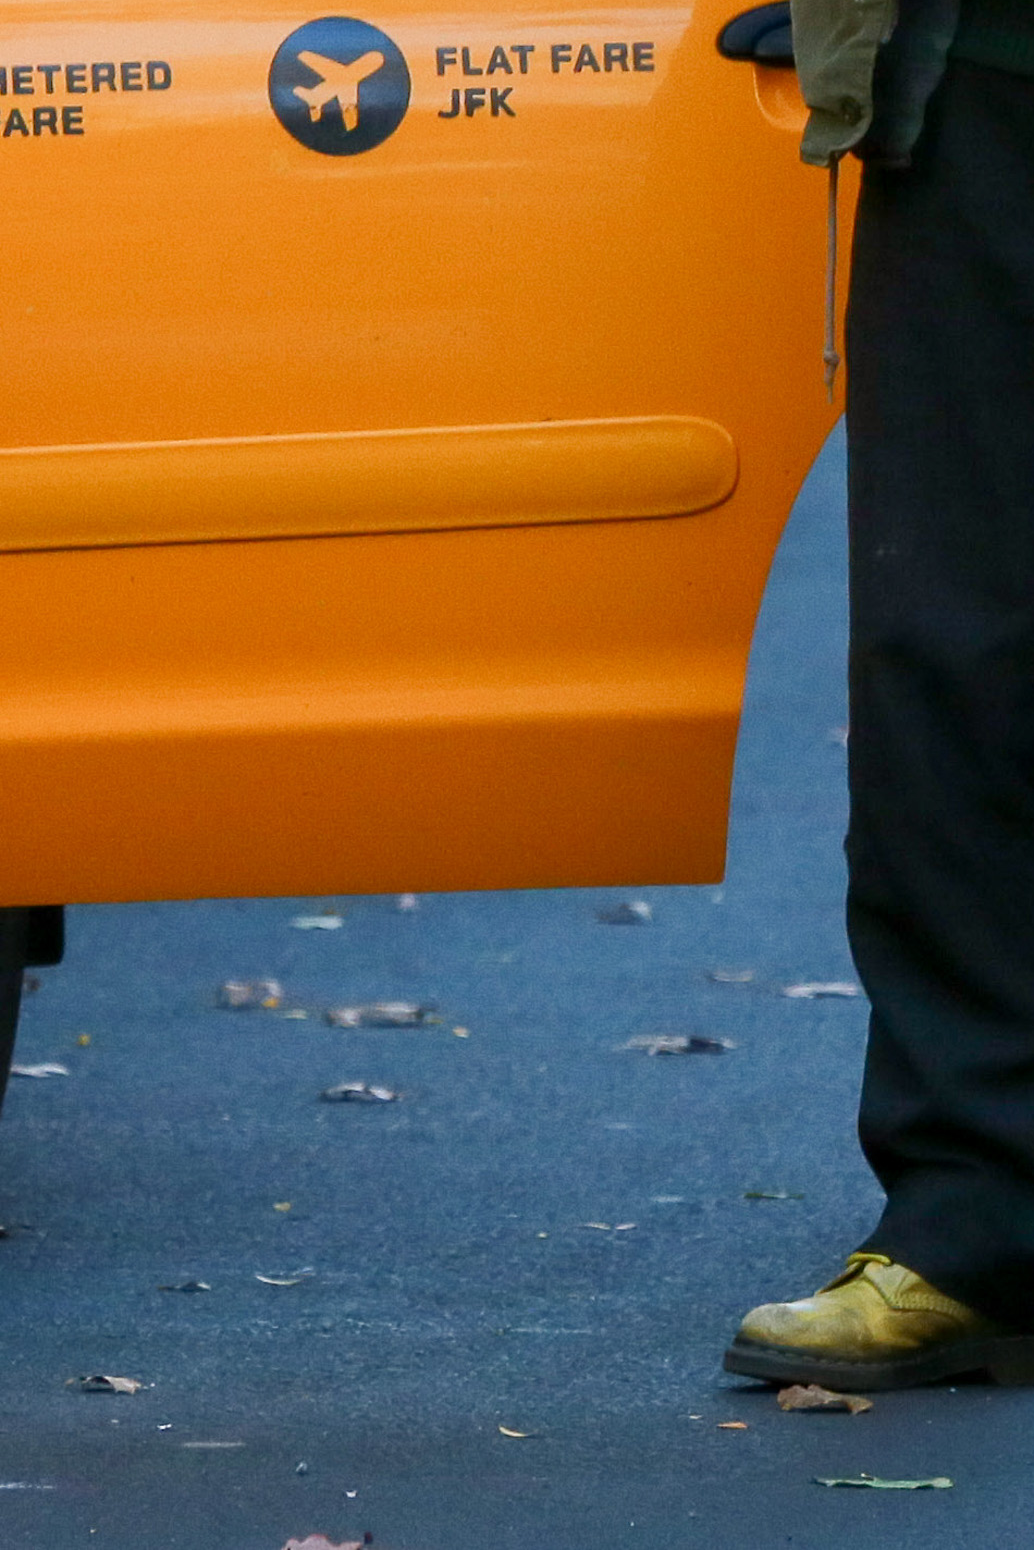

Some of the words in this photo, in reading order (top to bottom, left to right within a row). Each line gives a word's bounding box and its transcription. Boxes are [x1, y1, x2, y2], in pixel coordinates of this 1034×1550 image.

[434, 44, 535, 76] FLAT
[550, 41, 655, 73] FARE
[437, 87, 516, 118] JFK
[0, 106, 85, 138] ARE
